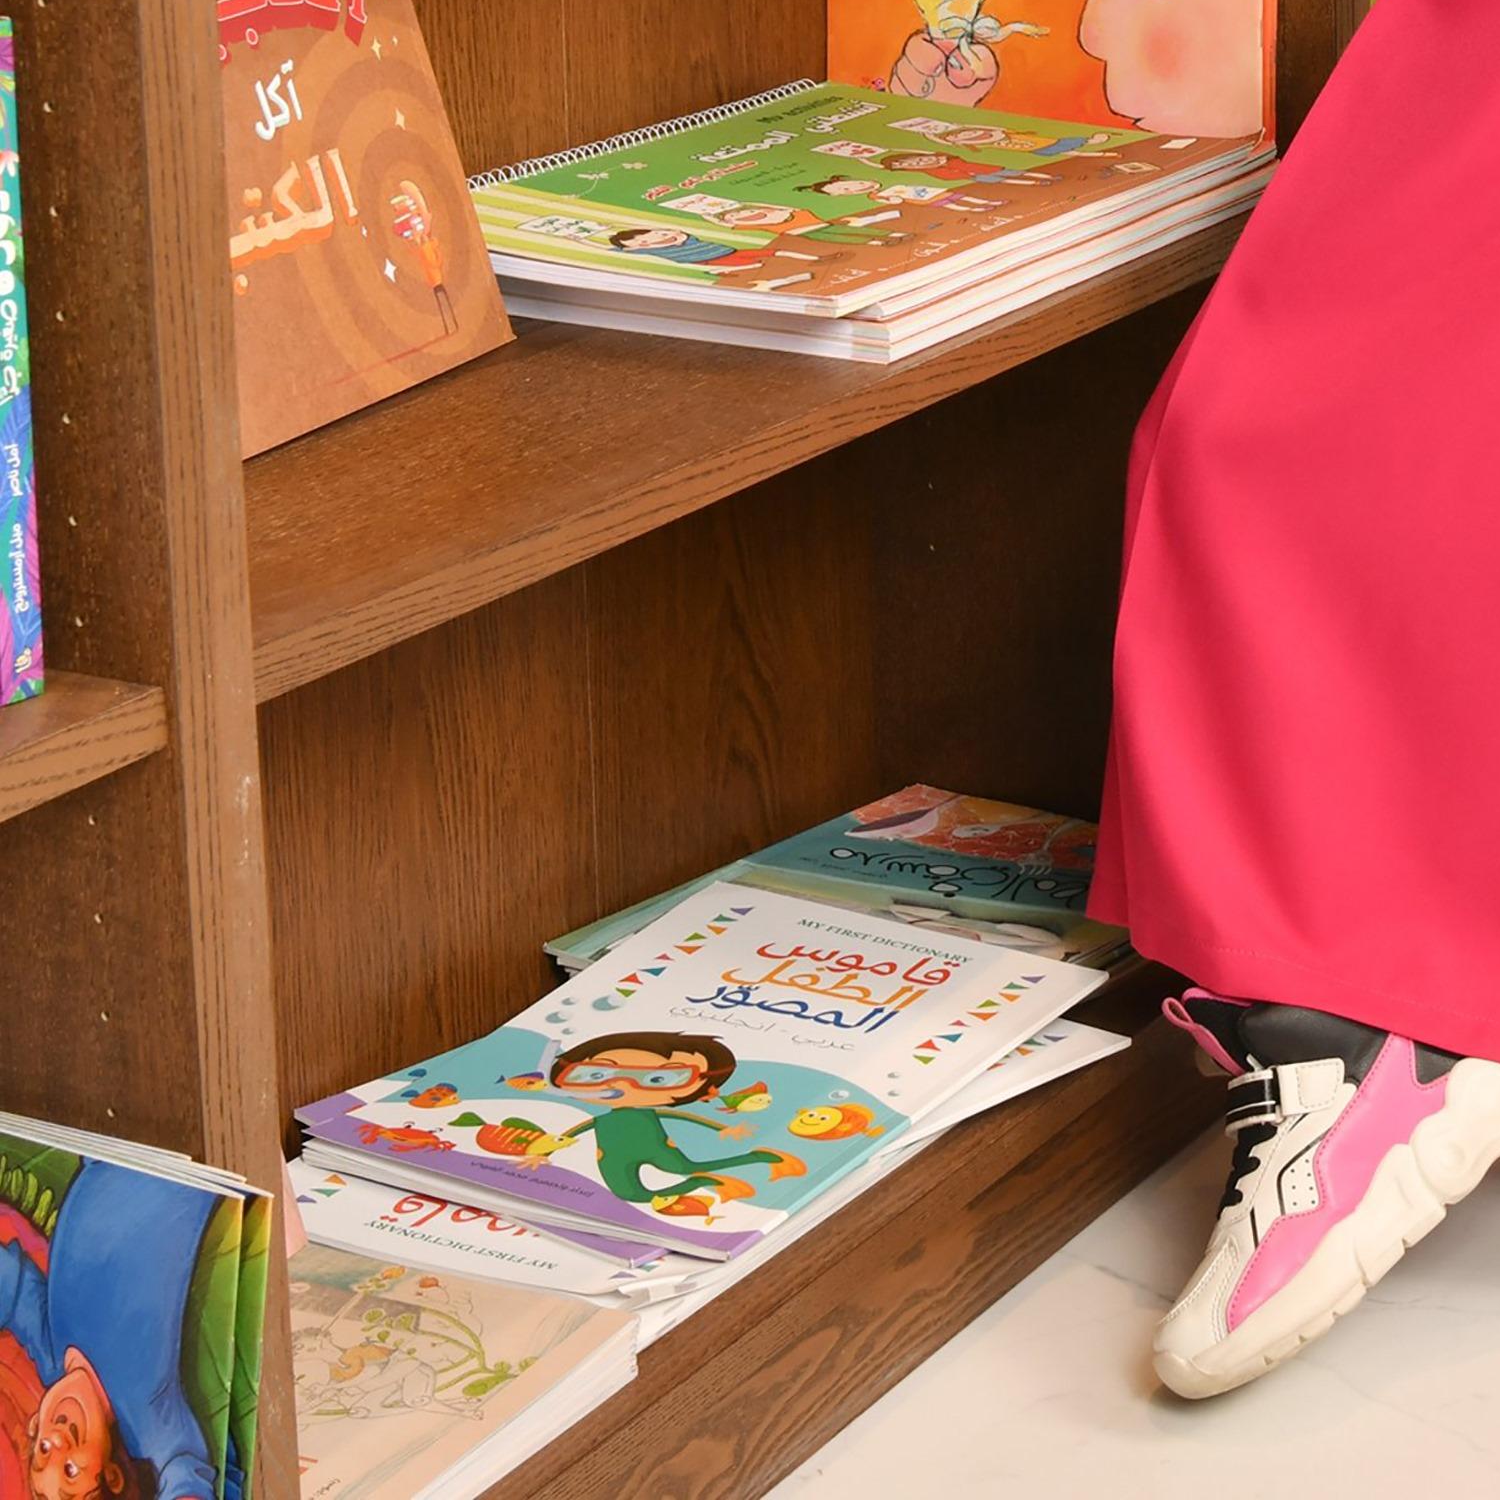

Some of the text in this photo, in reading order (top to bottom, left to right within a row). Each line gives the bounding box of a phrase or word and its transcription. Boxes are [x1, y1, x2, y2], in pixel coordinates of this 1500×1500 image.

[254, 59, 303, 141] آكل
[805, 100, 887, 135] أنشطتي
[756, 941, 962, 987] قاموس
[797, 917, 974, 964] MY FIRST DICTIONARY
[721, 958, 929, 1011] الطفل
[363, 1220, 559, 1271] MY FIRST DICTIONARY
